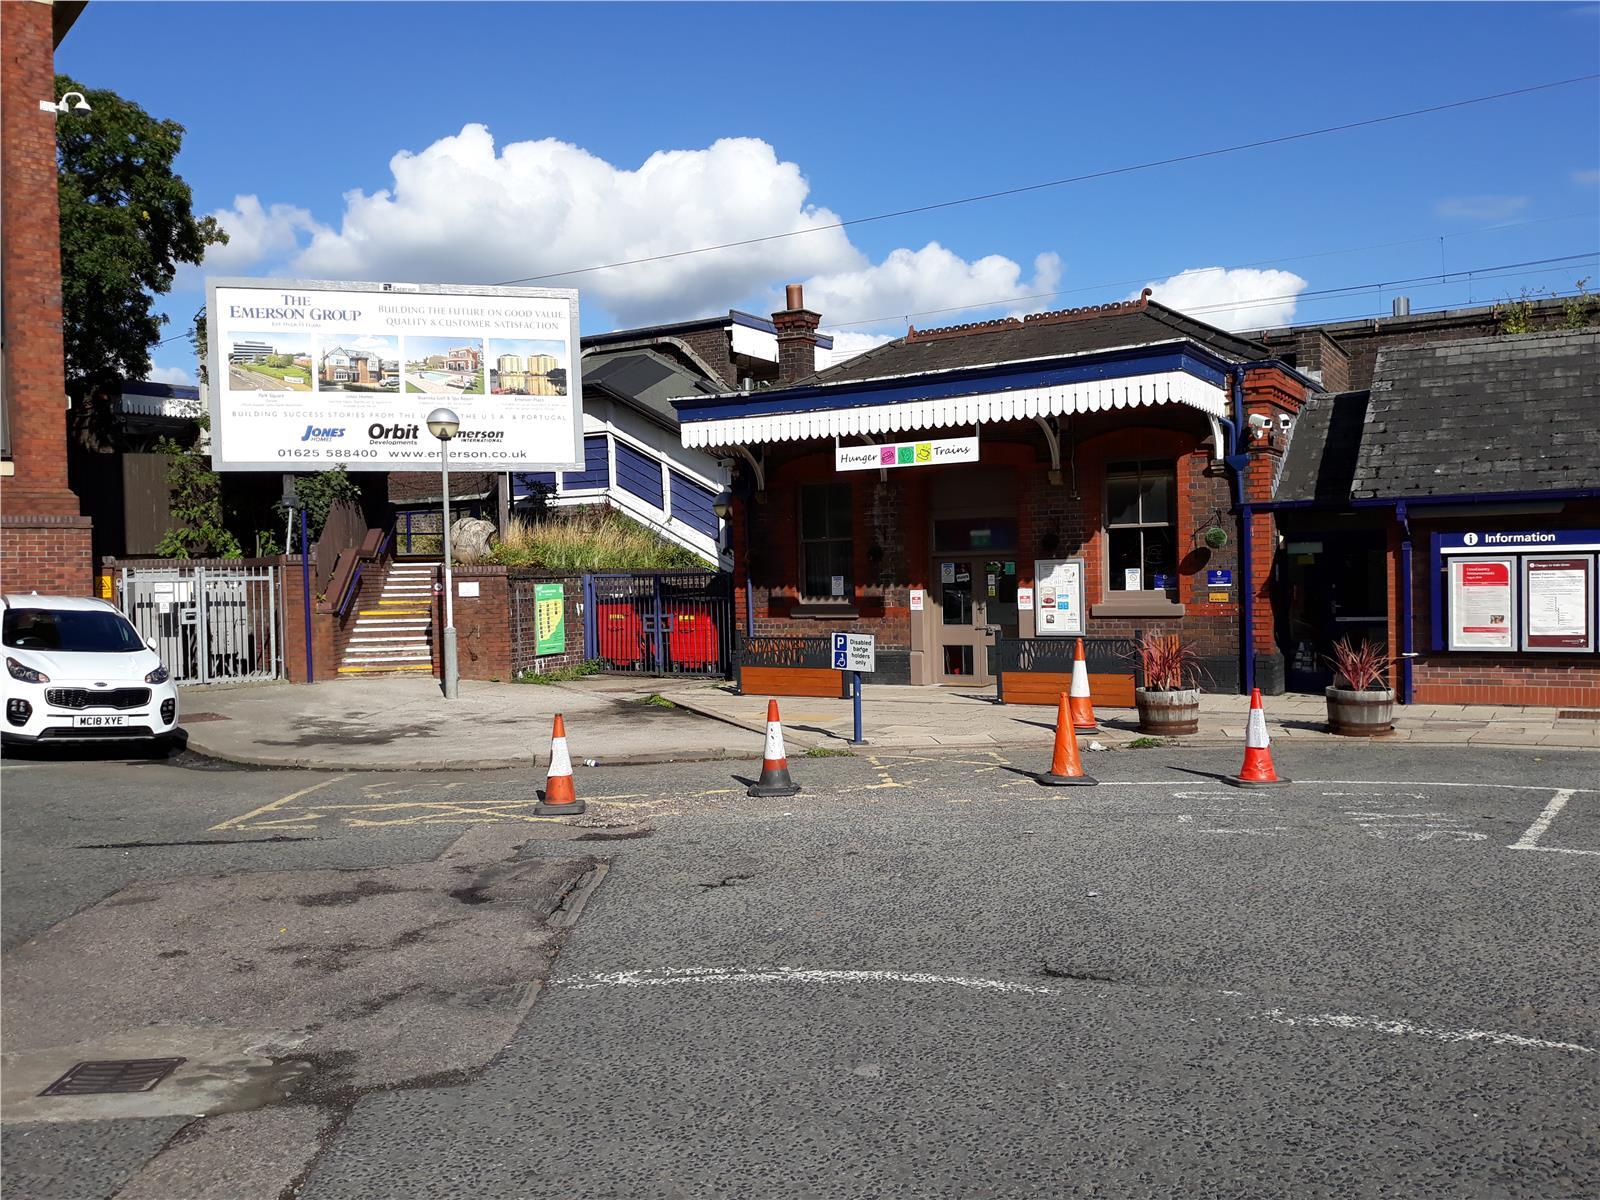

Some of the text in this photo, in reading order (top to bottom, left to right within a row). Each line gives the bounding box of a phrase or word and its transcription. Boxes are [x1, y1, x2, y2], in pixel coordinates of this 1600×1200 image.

[281, 294, 311, 306] THE
[230, 306, 362, 321] EMERSON GROUP
[378, 305, 566, 320] BUILDING THE FUTURE ON GOOD VALUE,
[386, 317, 427, 327] QUALITY
[438, 318, 491, 328] CUSTOMER
[494, 320, 559, 330] SATISFACTION
[301, 425, 346, 441] JONES
[368, 422, 419, 440] Orbit
[450, 430, 504, 439] merson
[278, 449, 320, 457] 01625
[326, 450, 378, 458] 588400
[840, 444, 971, 464] Hunger Trains
[1485, 532, 1556, 543] Information
[837, 637, 844, 648] P
[80, 717, 123, 726] MC18 XYE
